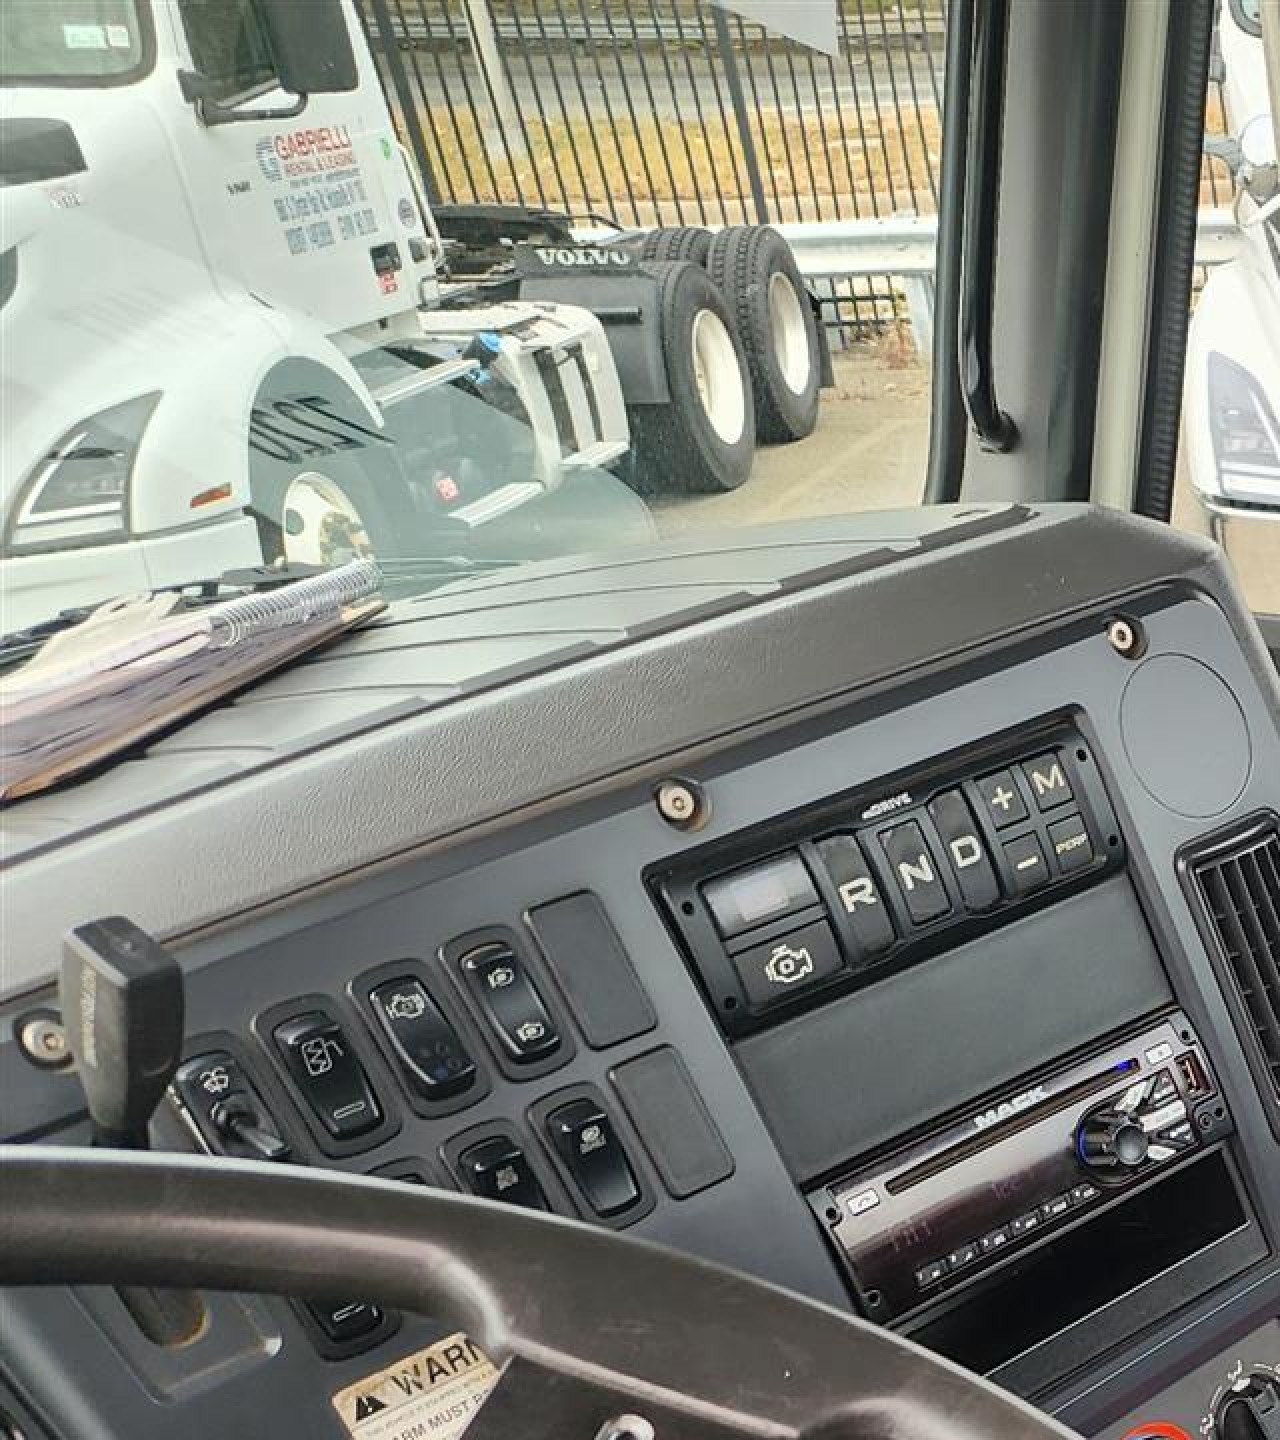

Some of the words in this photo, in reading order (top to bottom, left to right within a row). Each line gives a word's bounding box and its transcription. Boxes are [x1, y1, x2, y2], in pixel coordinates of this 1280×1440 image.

[274, 125, 352, 159] GABRIELLI
[536, 249, 631, 265] VOLVO
[1032, 764, 1066, 794] M
[951, 835, 982, 868] D
[898, 854, 935, 890] N
[839, 878, 878, 913] R
